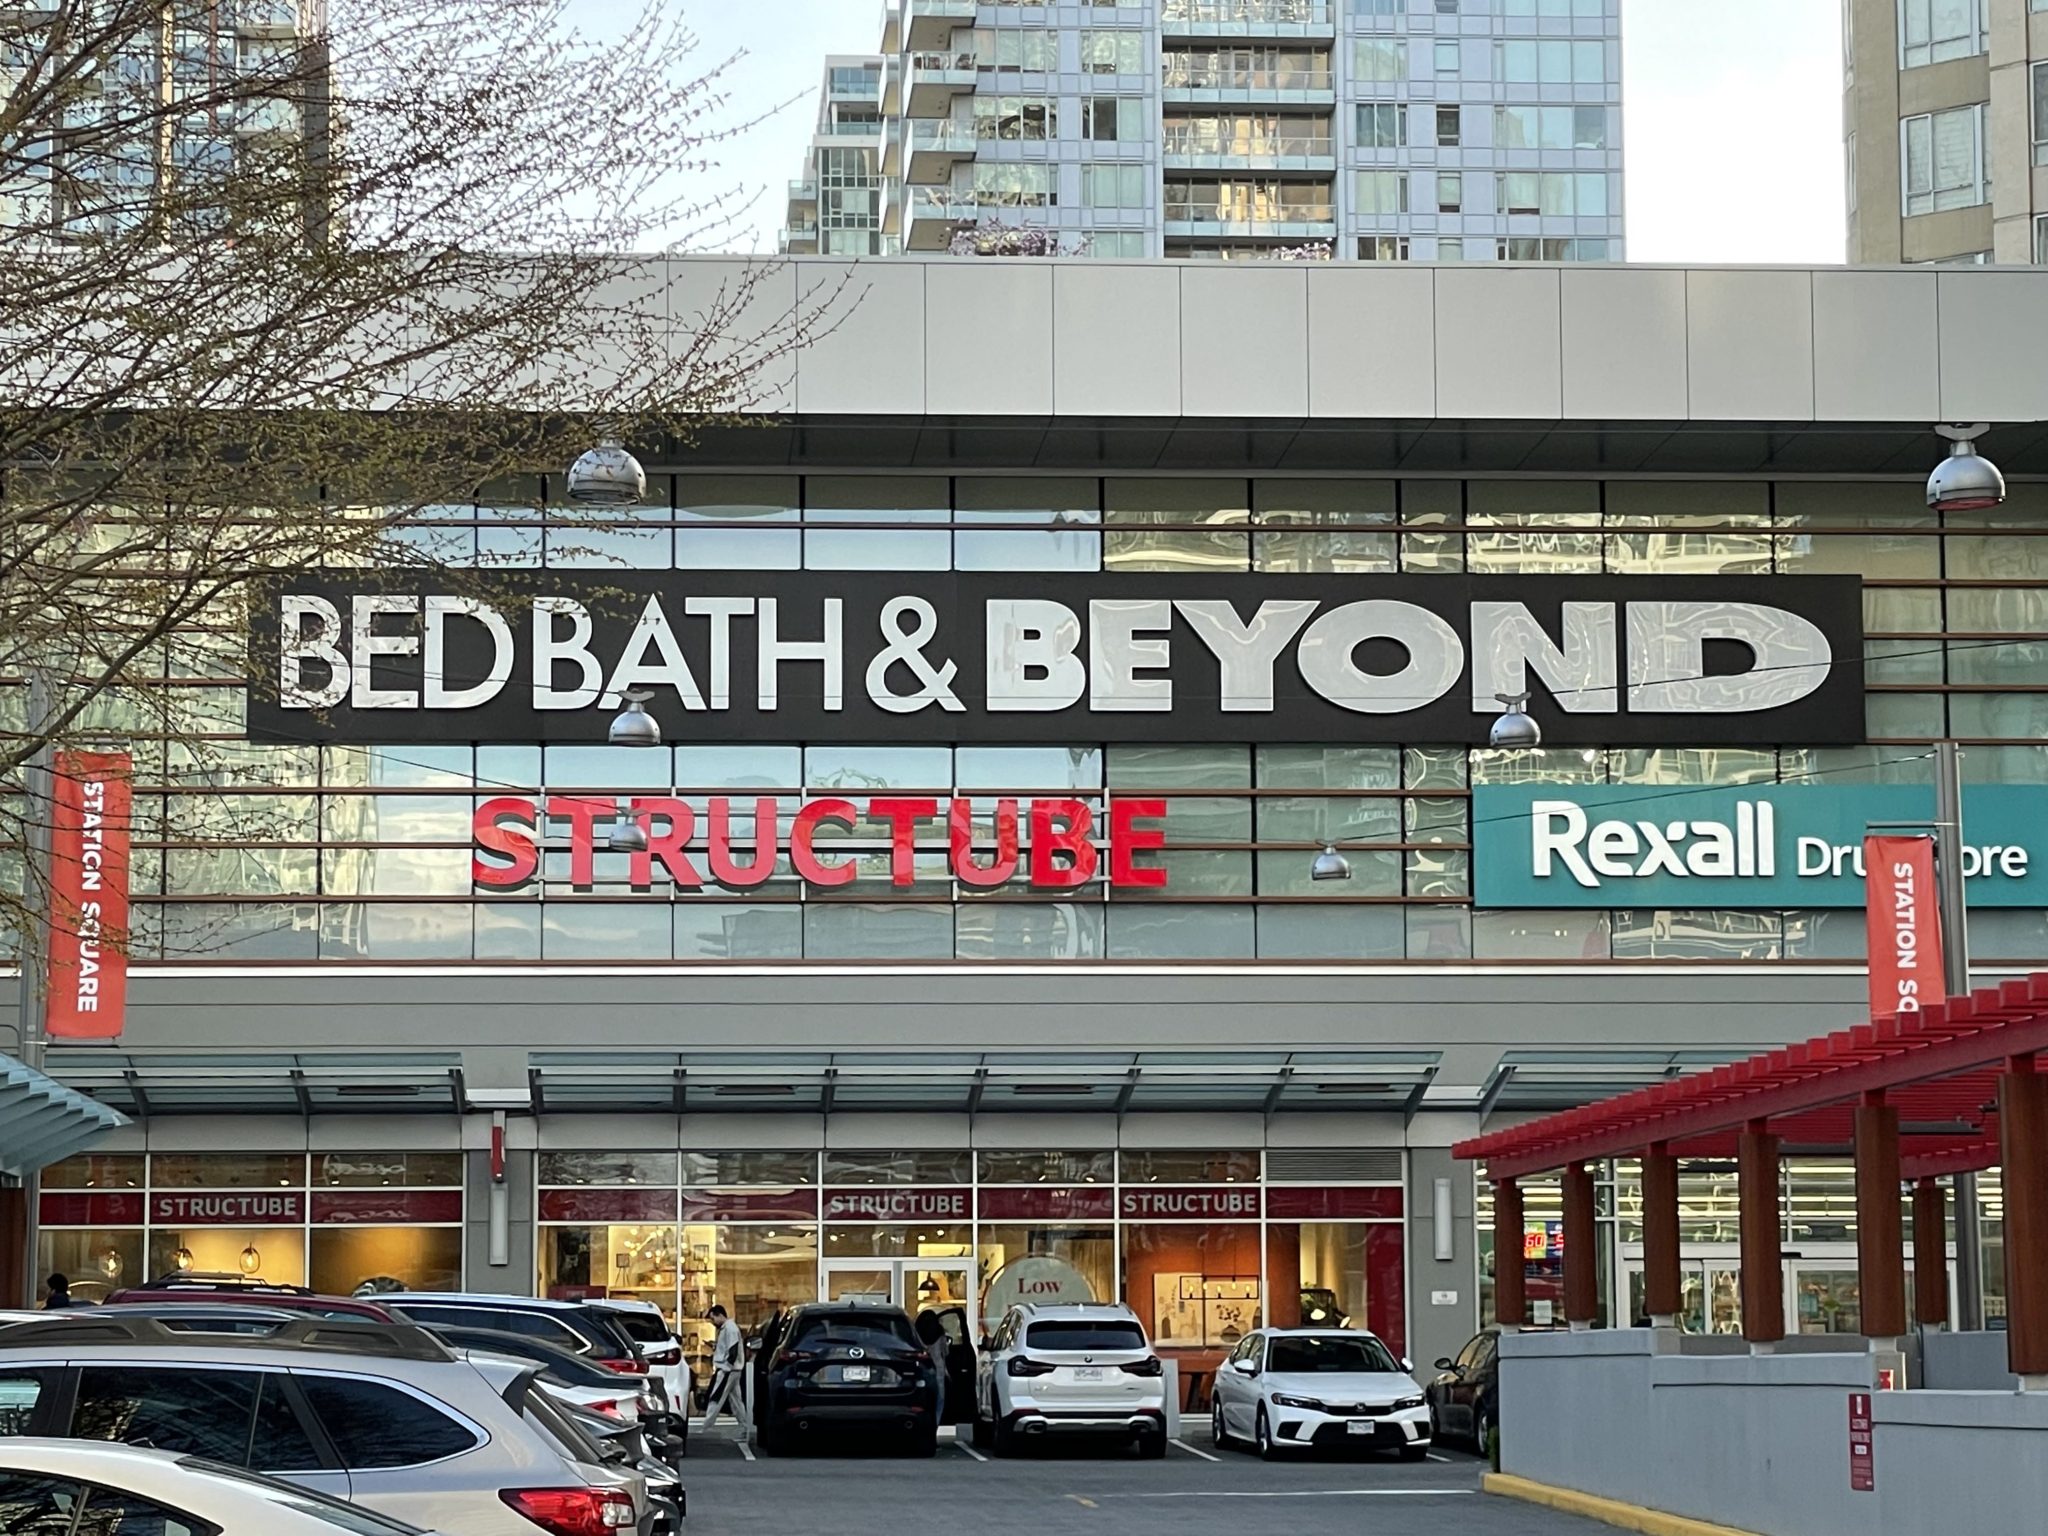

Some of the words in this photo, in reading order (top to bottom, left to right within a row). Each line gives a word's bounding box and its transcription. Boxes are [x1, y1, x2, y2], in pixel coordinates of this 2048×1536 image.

[280, 594, 515, 710] BED
[532, 592, 842, 711] BATH
[865, 595, 967, 713] &
[986, 598, 1832, 714] BEYOND
[82, 781, 105, 892] STATION
[473, 797, 1167, 890] STRUCTUBE
[1532, 800, 1776, 887] Rexall
[1797, 837, 1867, 877] Dru
[77, 901, 101, 1013] SQUARE
[1894, 862, 1917, 969] STATION
[159, 1197, 297, 1217] STRUCTUBE
[830, 1195, 964, 1214] STRUCTUBE
[1123, 1194, 1257, 1213] STRUCTUBE
[1018, 1278, 1063, 1294] Low
